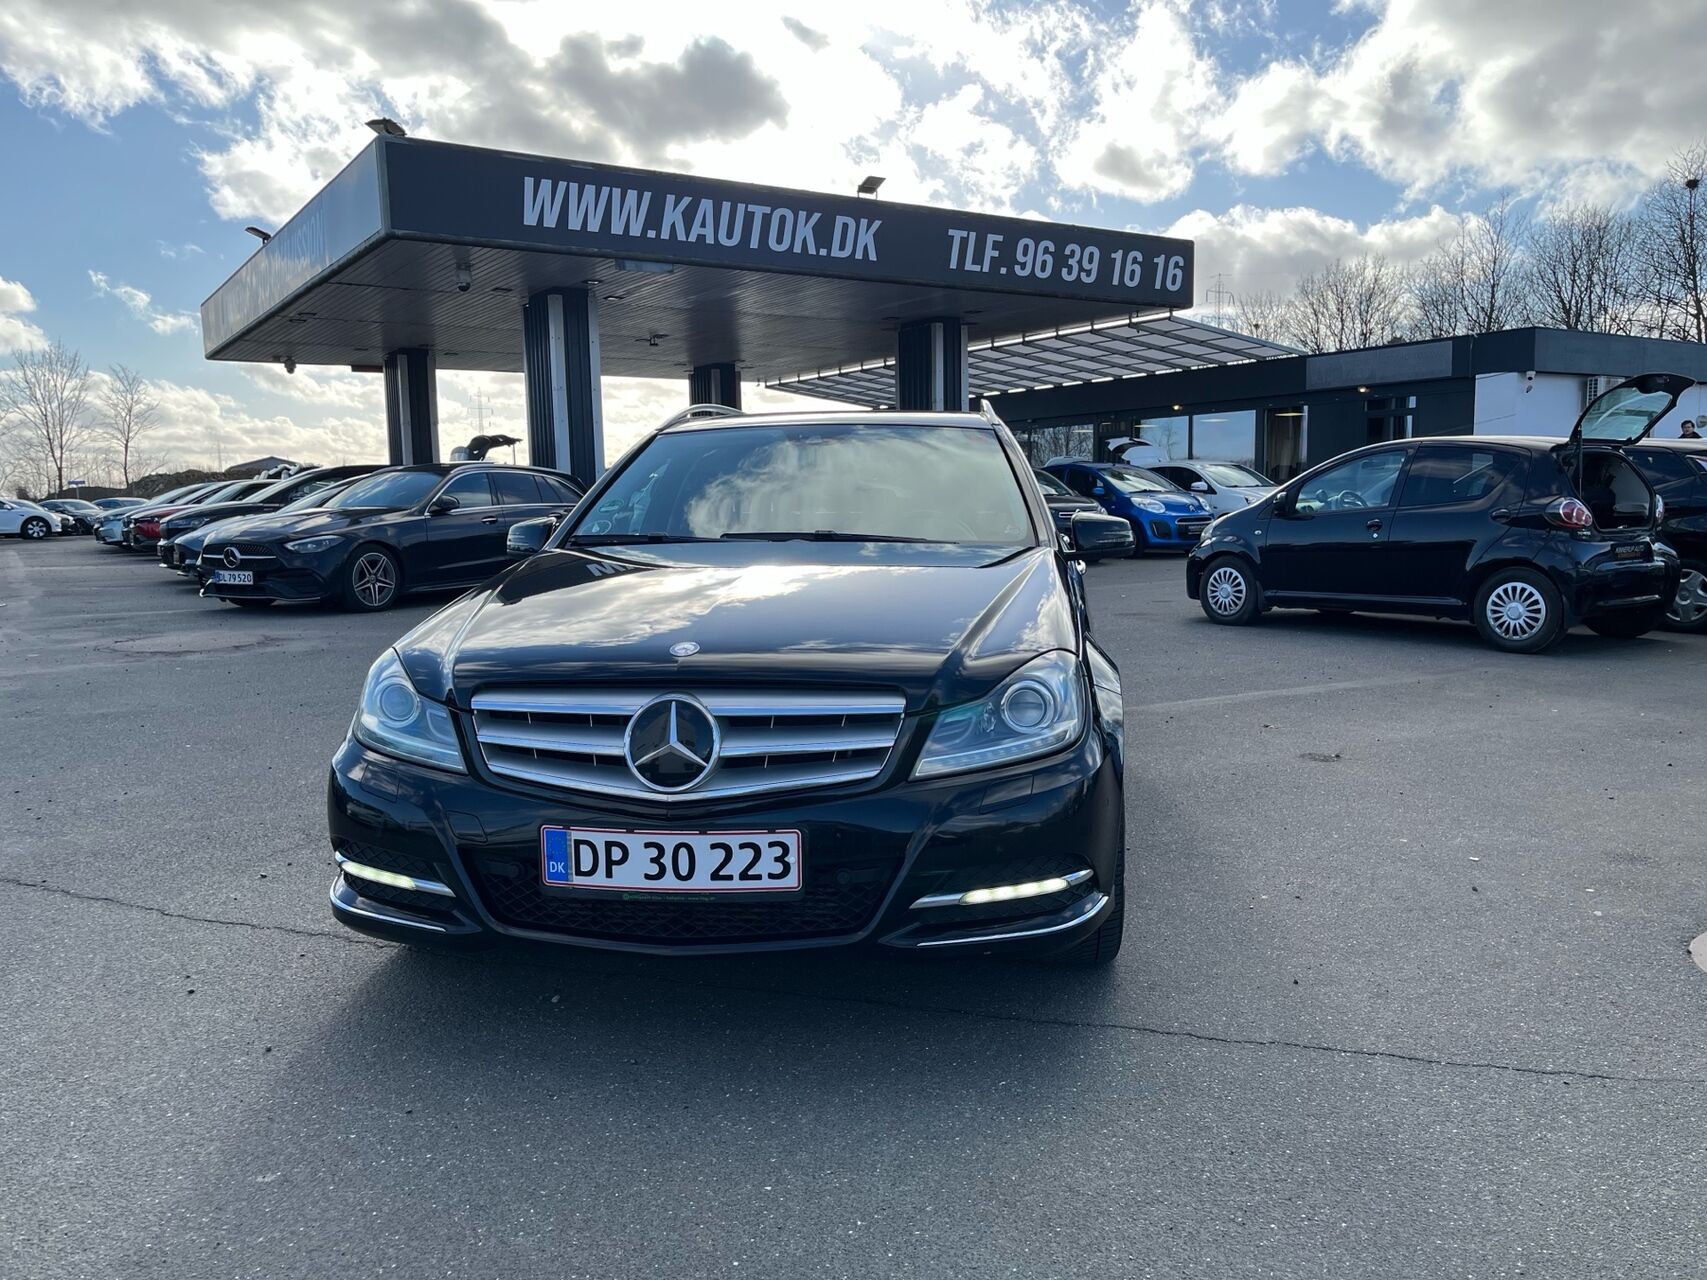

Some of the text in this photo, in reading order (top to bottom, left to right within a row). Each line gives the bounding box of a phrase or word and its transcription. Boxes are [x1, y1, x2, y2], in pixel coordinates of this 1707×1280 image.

[523, 177, 882, 262] WWW.KAUTOK.DK
[948, 229, 1185, 292] TLF. 96 39 16 16
[228, 573, 237, 582] 79
[237, 573, 252, 583] 520
[549, 861, 566, 874] DK
[573, 838, 792, 881] DP 30 223
